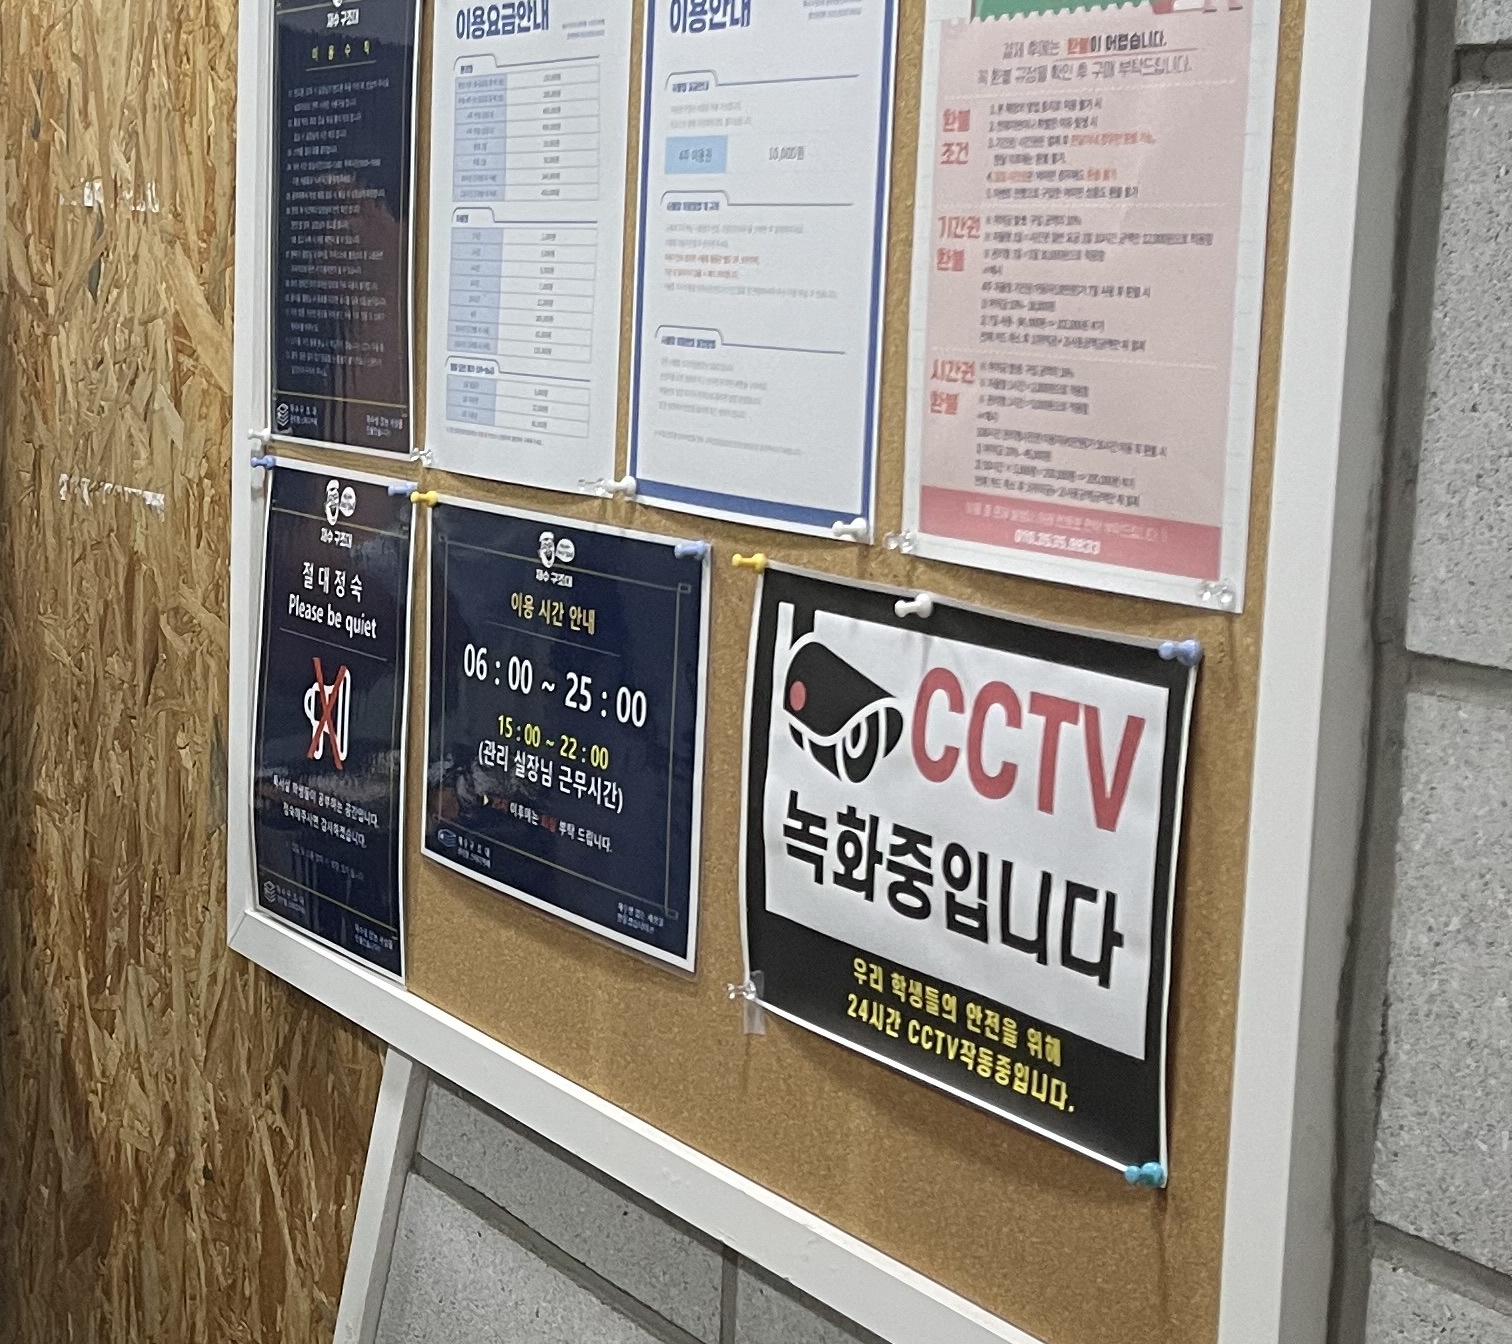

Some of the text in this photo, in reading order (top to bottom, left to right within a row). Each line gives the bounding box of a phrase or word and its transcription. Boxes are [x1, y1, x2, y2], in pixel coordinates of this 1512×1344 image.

[1105, 30, 1168, 53] 어렵습니다.
[940, 142, 969, 165] 조건
[938, 215, 981, 239] 기간권
[930, 359, 976, 384] 시간권
[289, 593, 377, 639] Please be quiet
[511, 592, 596, 635] 이용 시간 안내
[910, 667, 1147, 833] CCTV
[478, 739, 624, 814] (관리 실장님 근무시간)
[318, 792, 343, 814] 공부하는
[345, 802, 380, 829] 공간입니다.
[509, 801, 540, 826] 이후에는
[559, 820, 575, 840] 부탁
[577, 827, 613, 853] 드립니다.
[783, 790, 1125, 989] 녹화중입니다
[853, 957, 1062, 1067] 우리 학생들의 안전을 위해
[847, 993, 1075, 1113] 24시간 CCTV작동중입니다.
